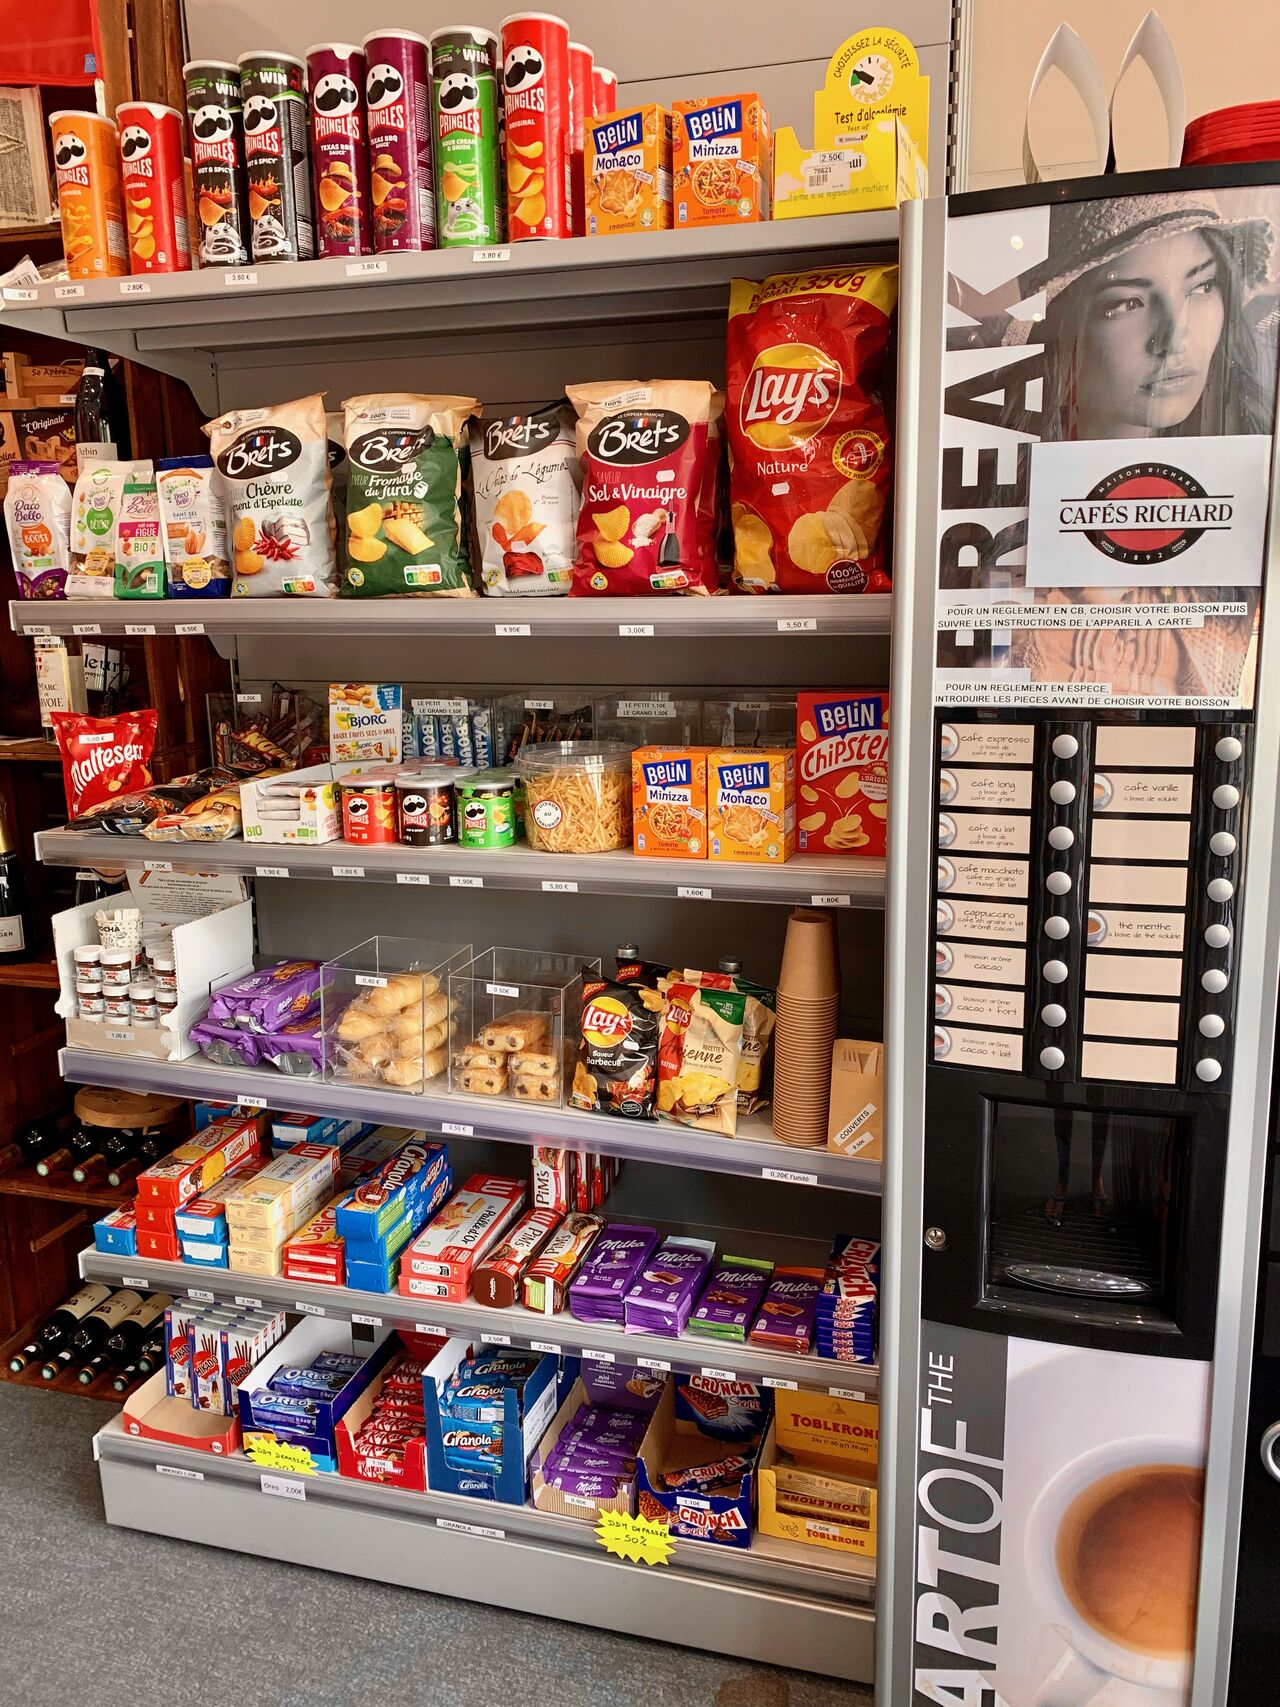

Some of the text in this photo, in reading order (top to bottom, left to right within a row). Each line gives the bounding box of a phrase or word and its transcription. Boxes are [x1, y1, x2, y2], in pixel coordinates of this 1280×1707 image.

[462, 48, 489, 64] WIN
[833, 36, 914, 78] CHOISISSEZ LA SÉCURITÉ
[260, 72, 287, 85] WIN
[505, 87, 544, 119] PRINGLES
[440, 111, 480, 137] PRINGLES
[509, 119, 535, 129] ORIGINAL
[834, 111, 854, 125] Test
[315, 115, 360, 140] PRINGLES
[194, 141, 235, 163] PRINGLES
[692, 143, 739, 158] Minizza
[596, 154, 641, 171] Monaco
[800, 272, 866, 293] 350g
[745, 366, 836, 426] Lay's
[598, 419, 680, 457] Brets
[521, 461, 569, 484] Légumes
[757, 460, 808, 476] Nature
[368, 470, 424, 487] Fromage
[597, 471, 622, 484] SAVEUR
[1098, 467, 1197, 494] MAISON RICHARD
[246, 482, 294, 499] Chèvre
[365, 486, 379, 497] du
[589, 482, 688, 505] Sel Vinaigre
[15, 499, 40, 511] Daco
[253, 497, 304, 510] d'Espelette
[15, 510, 42, 522] Bello
[1059, 503, 1233, 525] CAFÉS RICHARD
[24, 533, 49, 544] BOOST
[135, 527, 157, 537] FIGUE
[134, 542, 149, 552] BIO
[830, 567, 860, 579] 100%
[947, 604, 1246, 616] POUR UN REGLEMENT EN CB, CHOISIR VOTRE BOISSON PUIS
[787, 621, 802, 629] 5,50
[937, 617, 1192, 628] SUIVRE LES INSTRUCTIONS DE L'APPAREIL CARTE
[945, 683, 1109, 694] POUR UN REGLEMENT EN ESPECE,
[935, 695, 991, 703] INTRODUIRE
[1014, 696, 1049, 704] PIECES
[1050, 696, 1085, 705] AVANT
[1087, 697, 1101, 705] DE
[1104, 697, 1145, 706] CHOISIR
[1147, 698, 1182, 706] VOTRE
[1185, 698, 1230, 707] BOISSON
[986, 736, 1030, 746] expresso
[71, 743, 144, 796] Maltesers
[997, 779, 1016, 793] long
[1152, 784, 1178, 792] vanille
[650, 789, 689, 802] Minizza
[720, 791, 768, 806] Monaco
[536, 801, 558, 812] CUISSON
[246, 824, 263, 837] BIO
[981, 866, 1024, 875] macchiato
[820, 896, 840, 904] 1,80€
[963, 910, 1016, 920] cappuccino
[1136, 922, 1172, 931] menthe
[973, 963, 1003, 971] cacao
[963, 996, 988, 1004] boisson
[667, 1005, 692, 1023] Lay's
[956, 1005, 1017, 1016] cacao fort
[583, 1005, 632, 1035] Lay's
[962, 1037, 987, 1046] boisson
[592, 1050, 614, 1058] Saveur
[960, 1046, 1012, 1059] cacao lait
[586, 1057, 622, 1067] Barbecue
[839, 1110, 870, 1140] COUVERTS
[382, 1144, 428, 1191] Granola
[599, 1238, 646, 1250] Milka
[655, 1250, 703, 1262] Milka
[840, 1240, 877, 1298] CRUNCH
[715, 1271, 765, 1283] Milka
[769, 1281, 820, 1293] Milka
[194, 1354, 219, 1378] MIKADO
[227, 1361, 253, 1384] MIKADO
[474, 1358, 526, 1376] Granola
[284, 1369, 331, 1380] OREO
[709, 1370, 727, 1378] 2,00€
[927, 1352, 954, 1406] THE
[691, 1374, 755, 1396] CRUNCH
[259, 1394, 308, 1406] OREO
[442, 1431, 493, 1447] Granola
[583, 1458, 609, 1467] Milka
[691, 1455, 743, 1478] CRUNCH
[264, 1482, 303, 1496] Oreo 2,00€
[458, 1479, 488, 1491] Granola
[575, 1480, 602, 1493] Milka
[680, 1508, 741, 1528] CRUNCH
[624, 1535, 648, 1547] 50%
[806, 1528, 866, 1548] TOBLERONE
